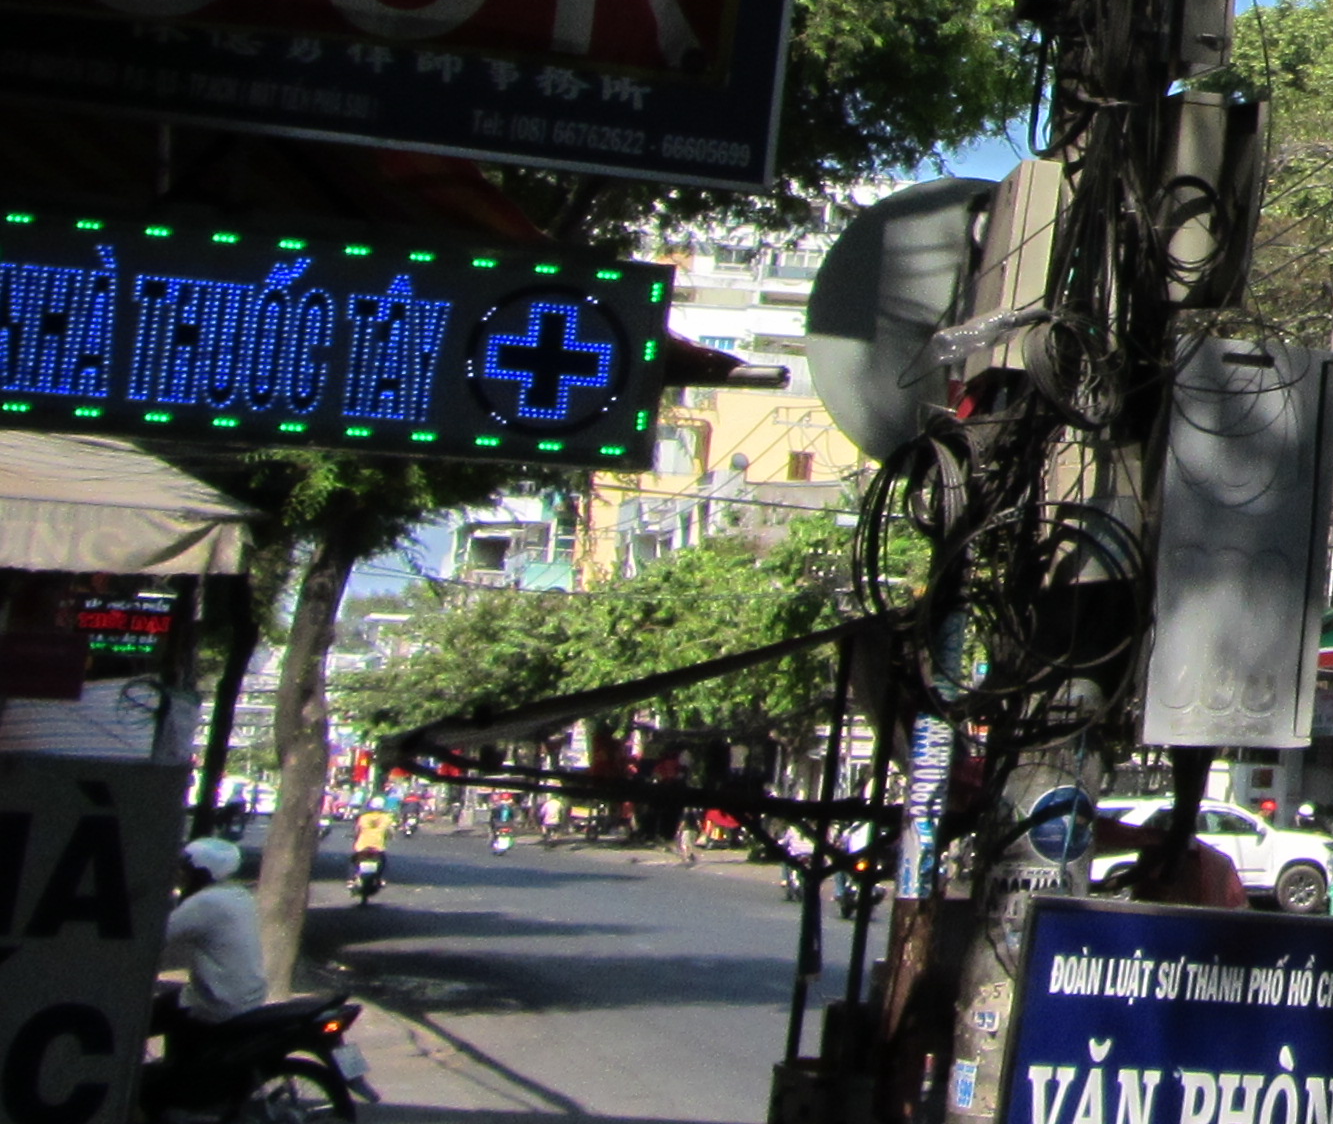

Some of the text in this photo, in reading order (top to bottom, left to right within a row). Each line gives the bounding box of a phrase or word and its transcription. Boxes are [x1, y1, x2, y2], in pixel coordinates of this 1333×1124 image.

[472, 109, 502, 138] Tel:
[510, 113, 547, 145] (08)
[552, 120, 645, 156] 66762622
[661, 134, 751, 168] 66605699
[127, 257, 335, 414] THUỐC
[342, 274, 451, 422] TÂY
[1048, 946, 1101, 996] ĐOÀN
[1104, 949, 1155, 1006] LUẬT
[1155, 955, 1185, 999] SƯ
[1185, 955, 1244, 1003] THÀNH
[1246, 953, 1290, 1006] PHỐ
[1287, 954, 1317, 1007] HỒ
[1028, 1038, 1162, 1124] VĂN
